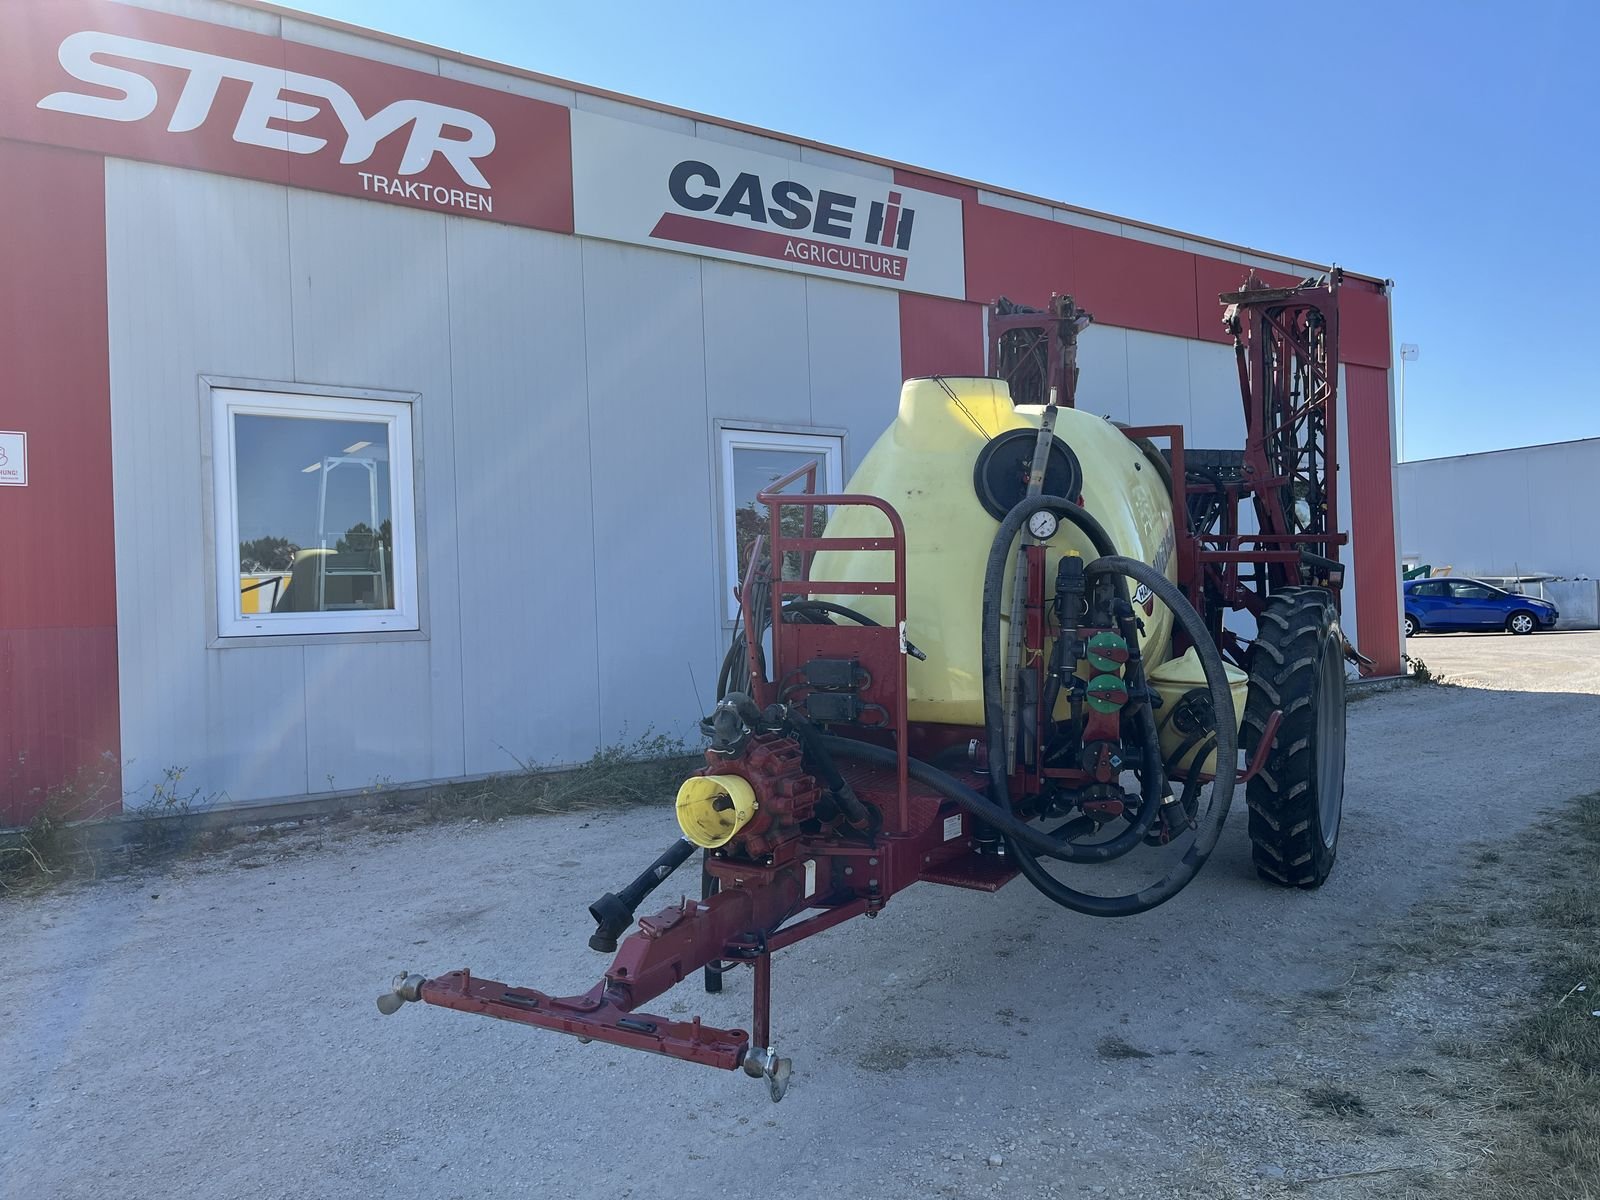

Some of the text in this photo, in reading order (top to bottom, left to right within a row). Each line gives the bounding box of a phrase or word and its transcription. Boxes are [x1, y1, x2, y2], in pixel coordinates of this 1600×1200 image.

[36, 30, 497, 190] STEYR
[358, 171, 493, 213] TRAKTOREN
[668, 160, 857, 239] CASE
[784, 240, 901, 276] AGRICULTURE
